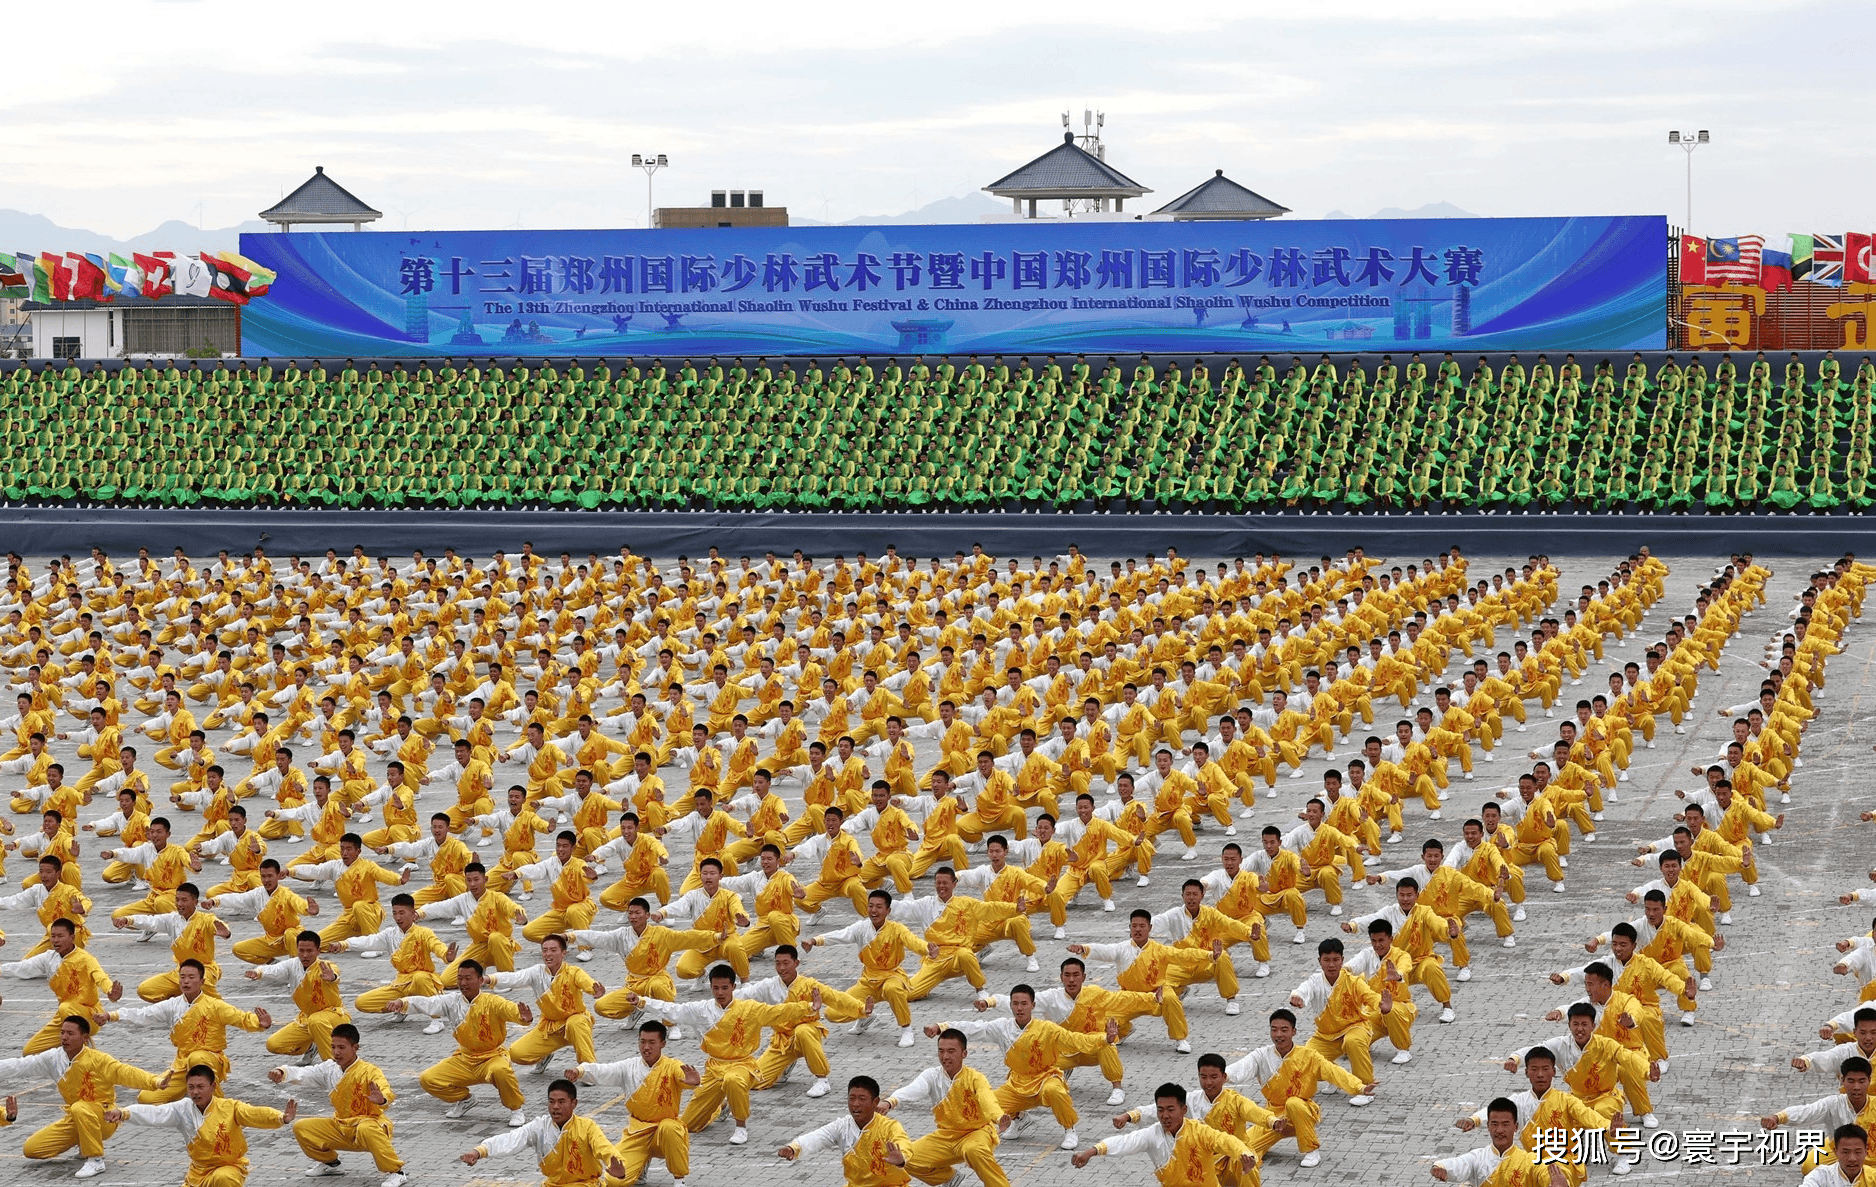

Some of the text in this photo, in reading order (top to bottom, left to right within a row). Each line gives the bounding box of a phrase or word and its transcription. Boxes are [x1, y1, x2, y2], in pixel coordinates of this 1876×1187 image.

[400, 246, 1484, 296] 第十三届郑州国际少林武术节暨中国郑州国际少林武术大赛
[484, 294, 1391, 314] The 13th Zhengzhou International Shaolin Wushu Festival & China Zhengzhou International Shaolin Wushu Competition
